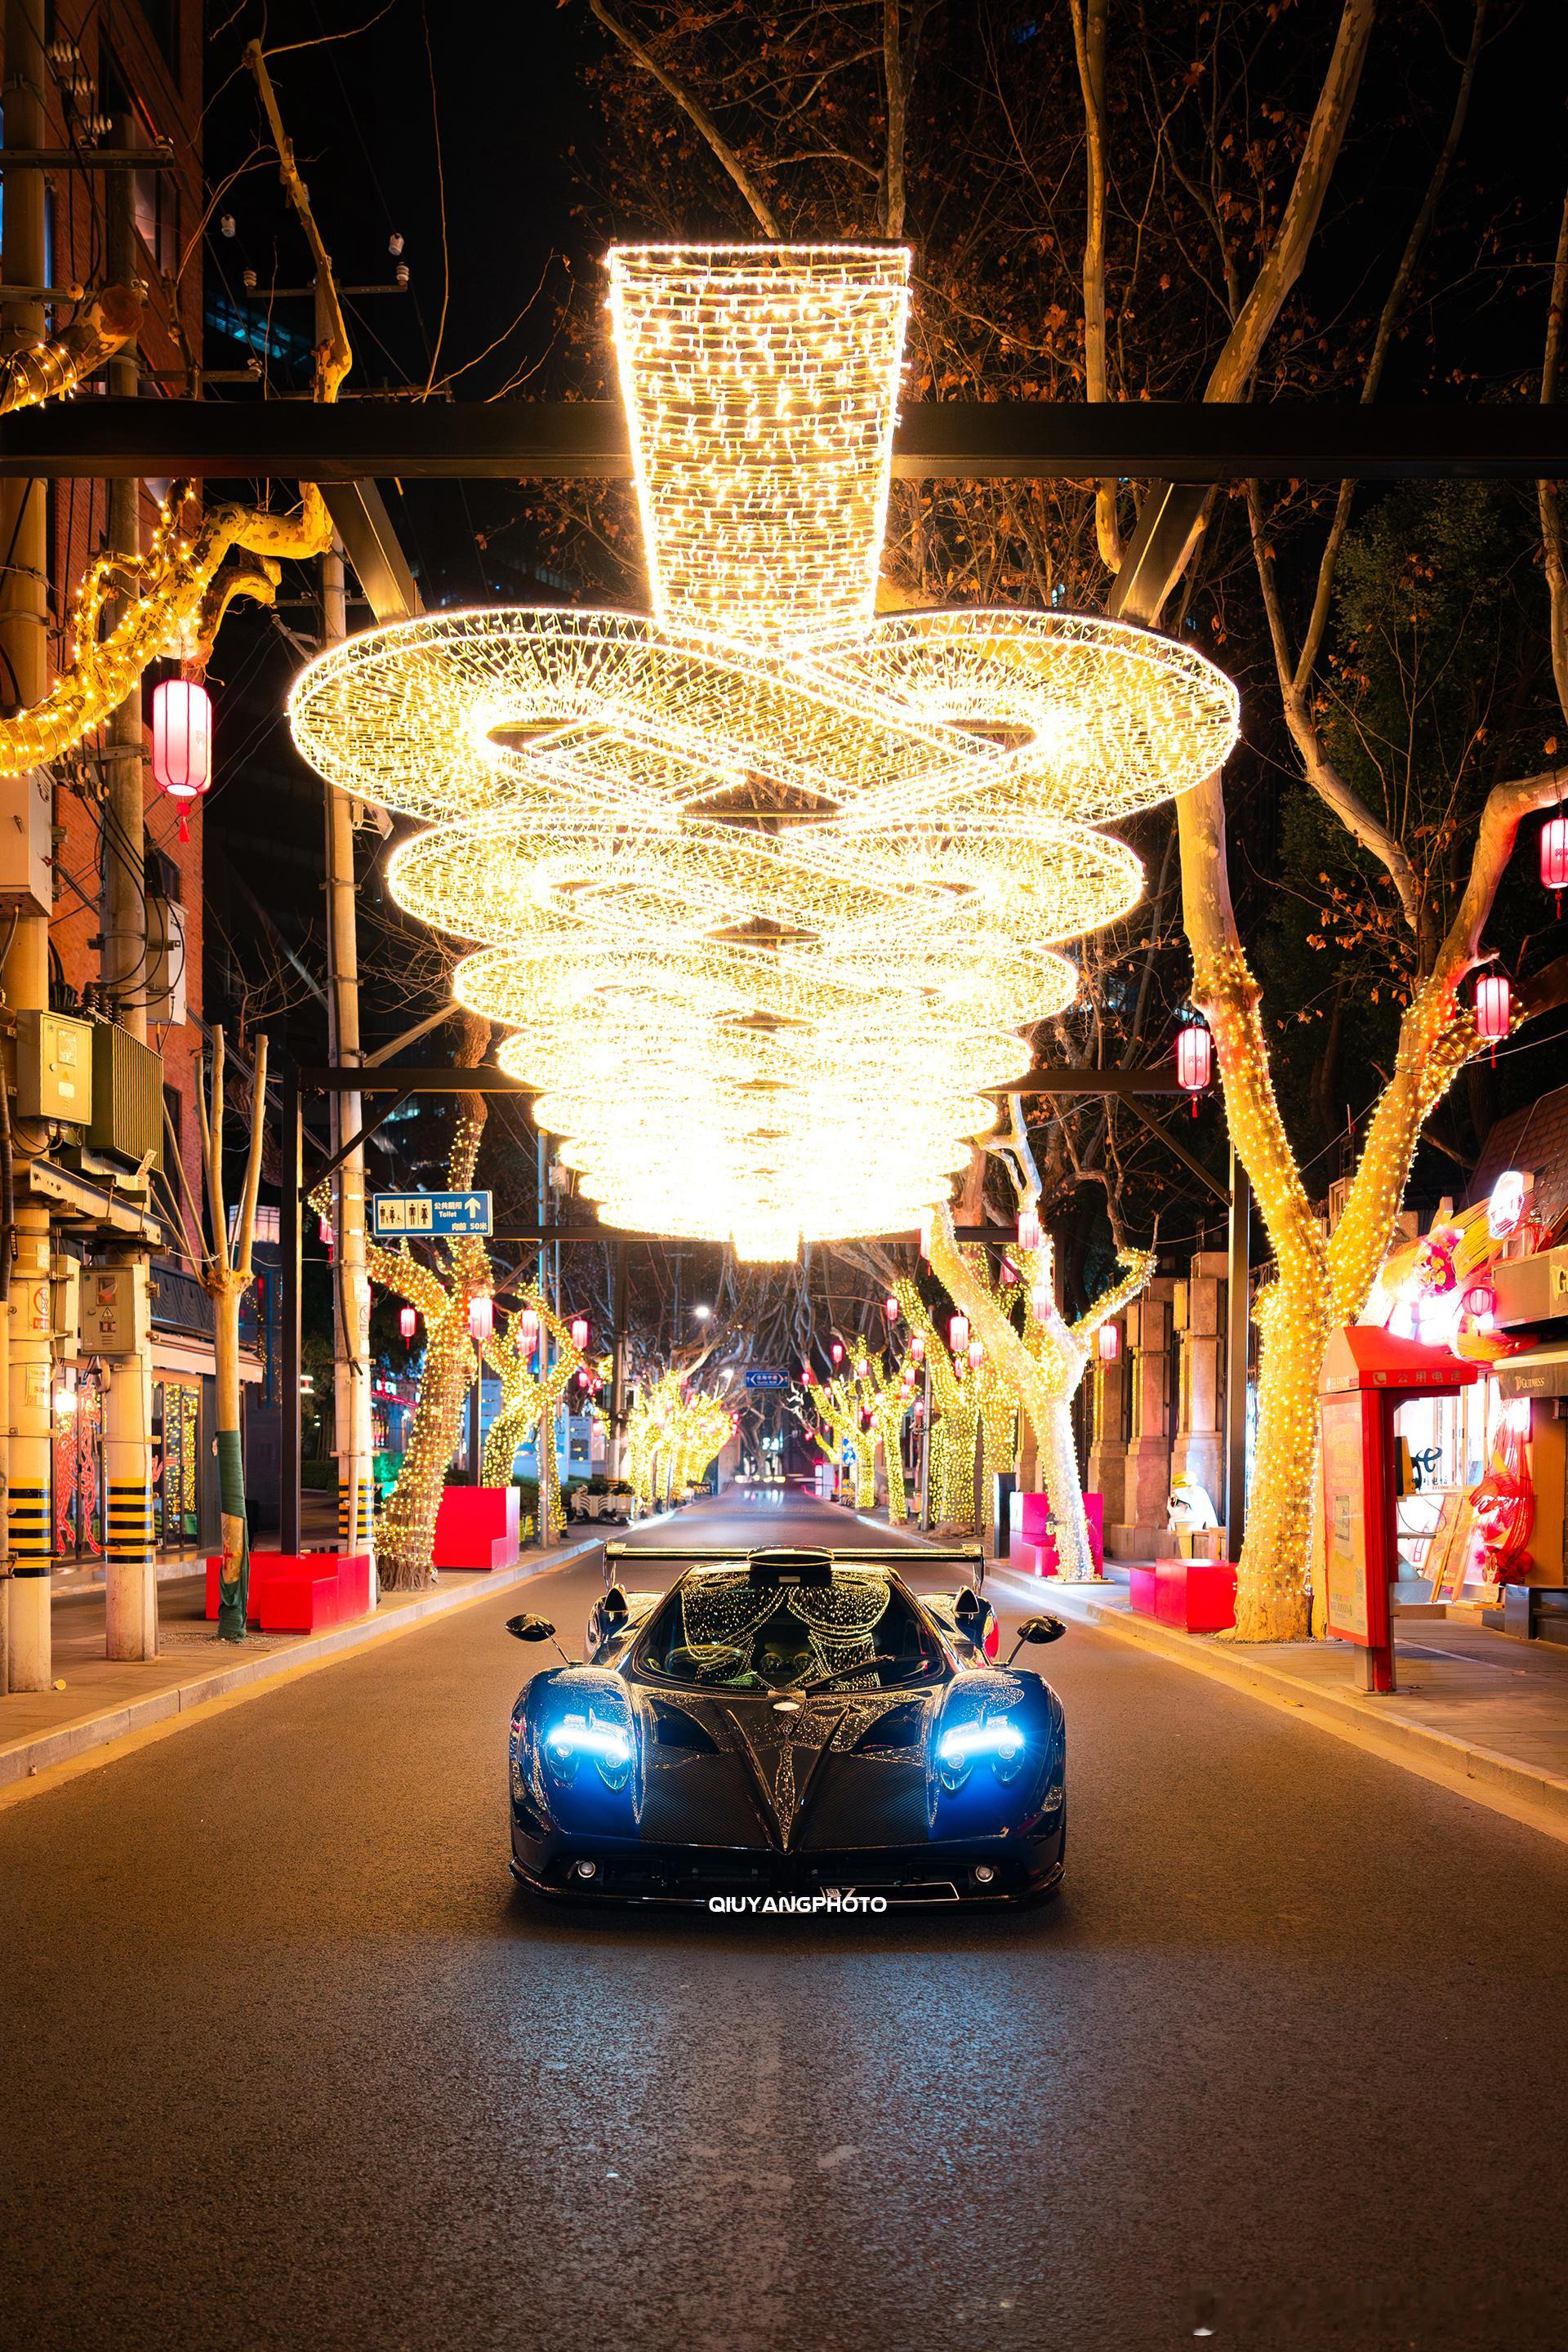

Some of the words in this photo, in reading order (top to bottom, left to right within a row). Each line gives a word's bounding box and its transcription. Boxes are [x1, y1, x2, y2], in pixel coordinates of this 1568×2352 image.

[470, 1222, 488, 1231] 50米
[1397, 1370, 1462, 1383] 公用电话
